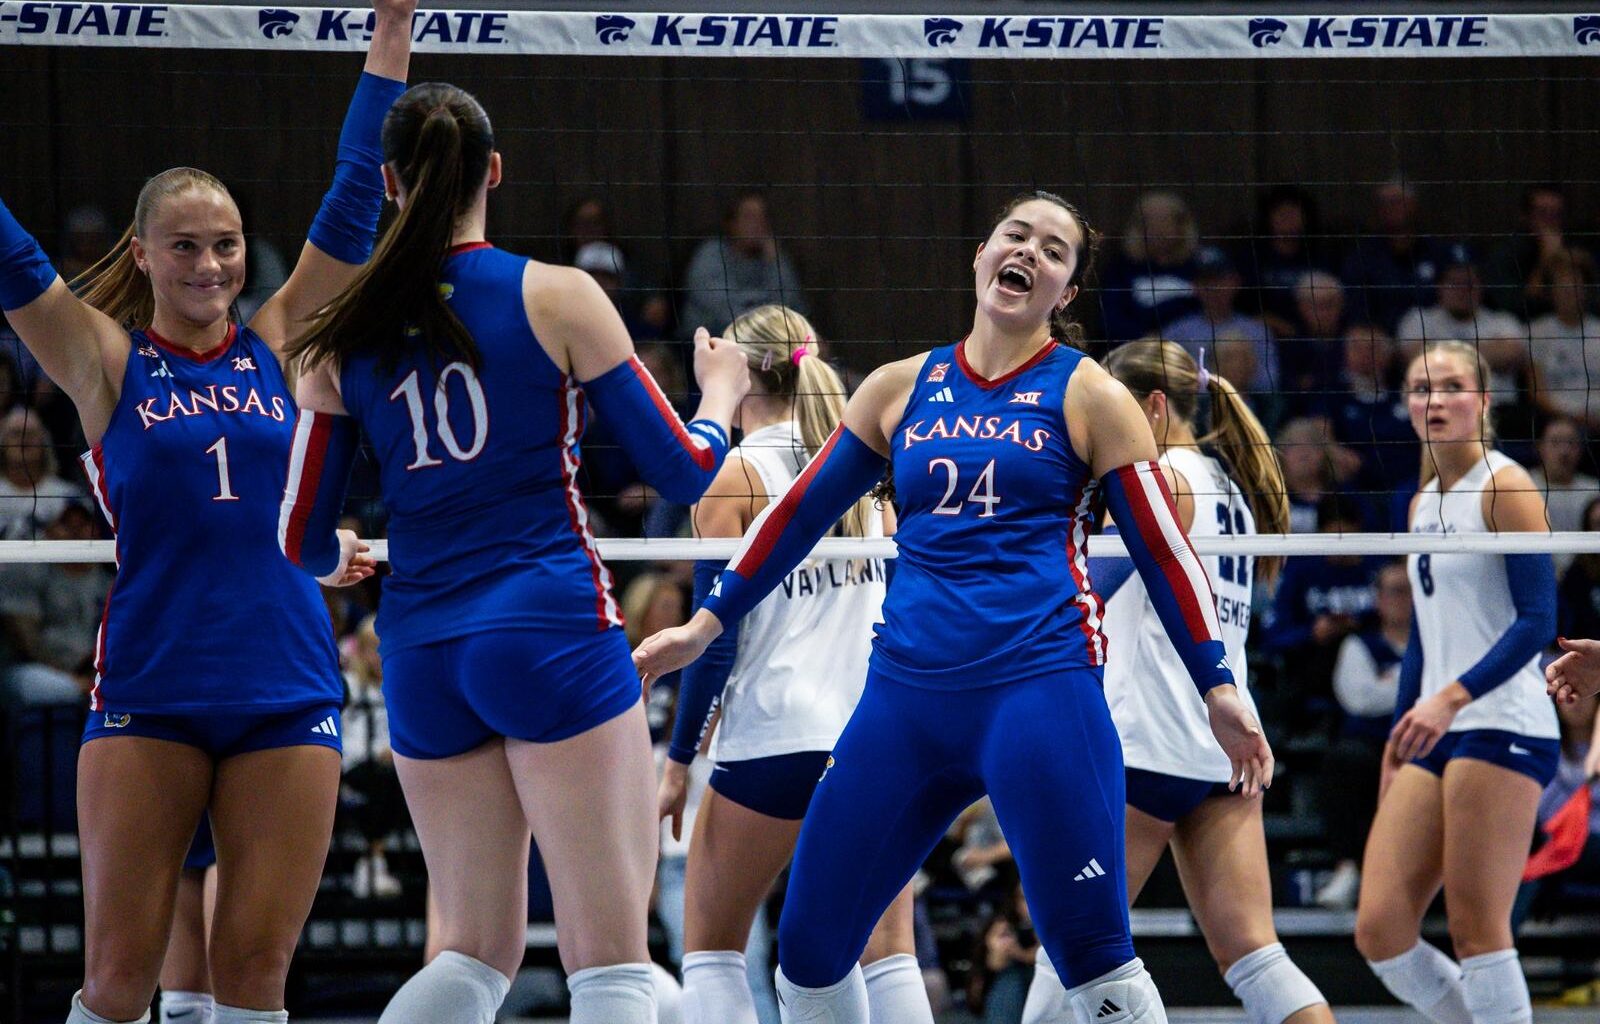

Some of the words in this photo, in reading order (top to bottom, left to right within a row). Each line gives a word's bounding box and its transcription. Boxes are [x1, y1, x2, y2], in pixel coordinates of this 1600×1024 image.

[0, 2, 168, 36] -STATE
[651, 15, 838, 47] K-STATE
[978, 18, 1164, 48] K-STATE
[1302, 17, 1488, 48] K-STATE
[883, 57, 951, 104] 15
[134, 384, 286, 431] KANSAS
[389, 361, 489, 471] 10
[903, 415, 1051, 452] KANSAS
[205, 436, 240, 501] 1
[928, 458, 1002, 518] 24
